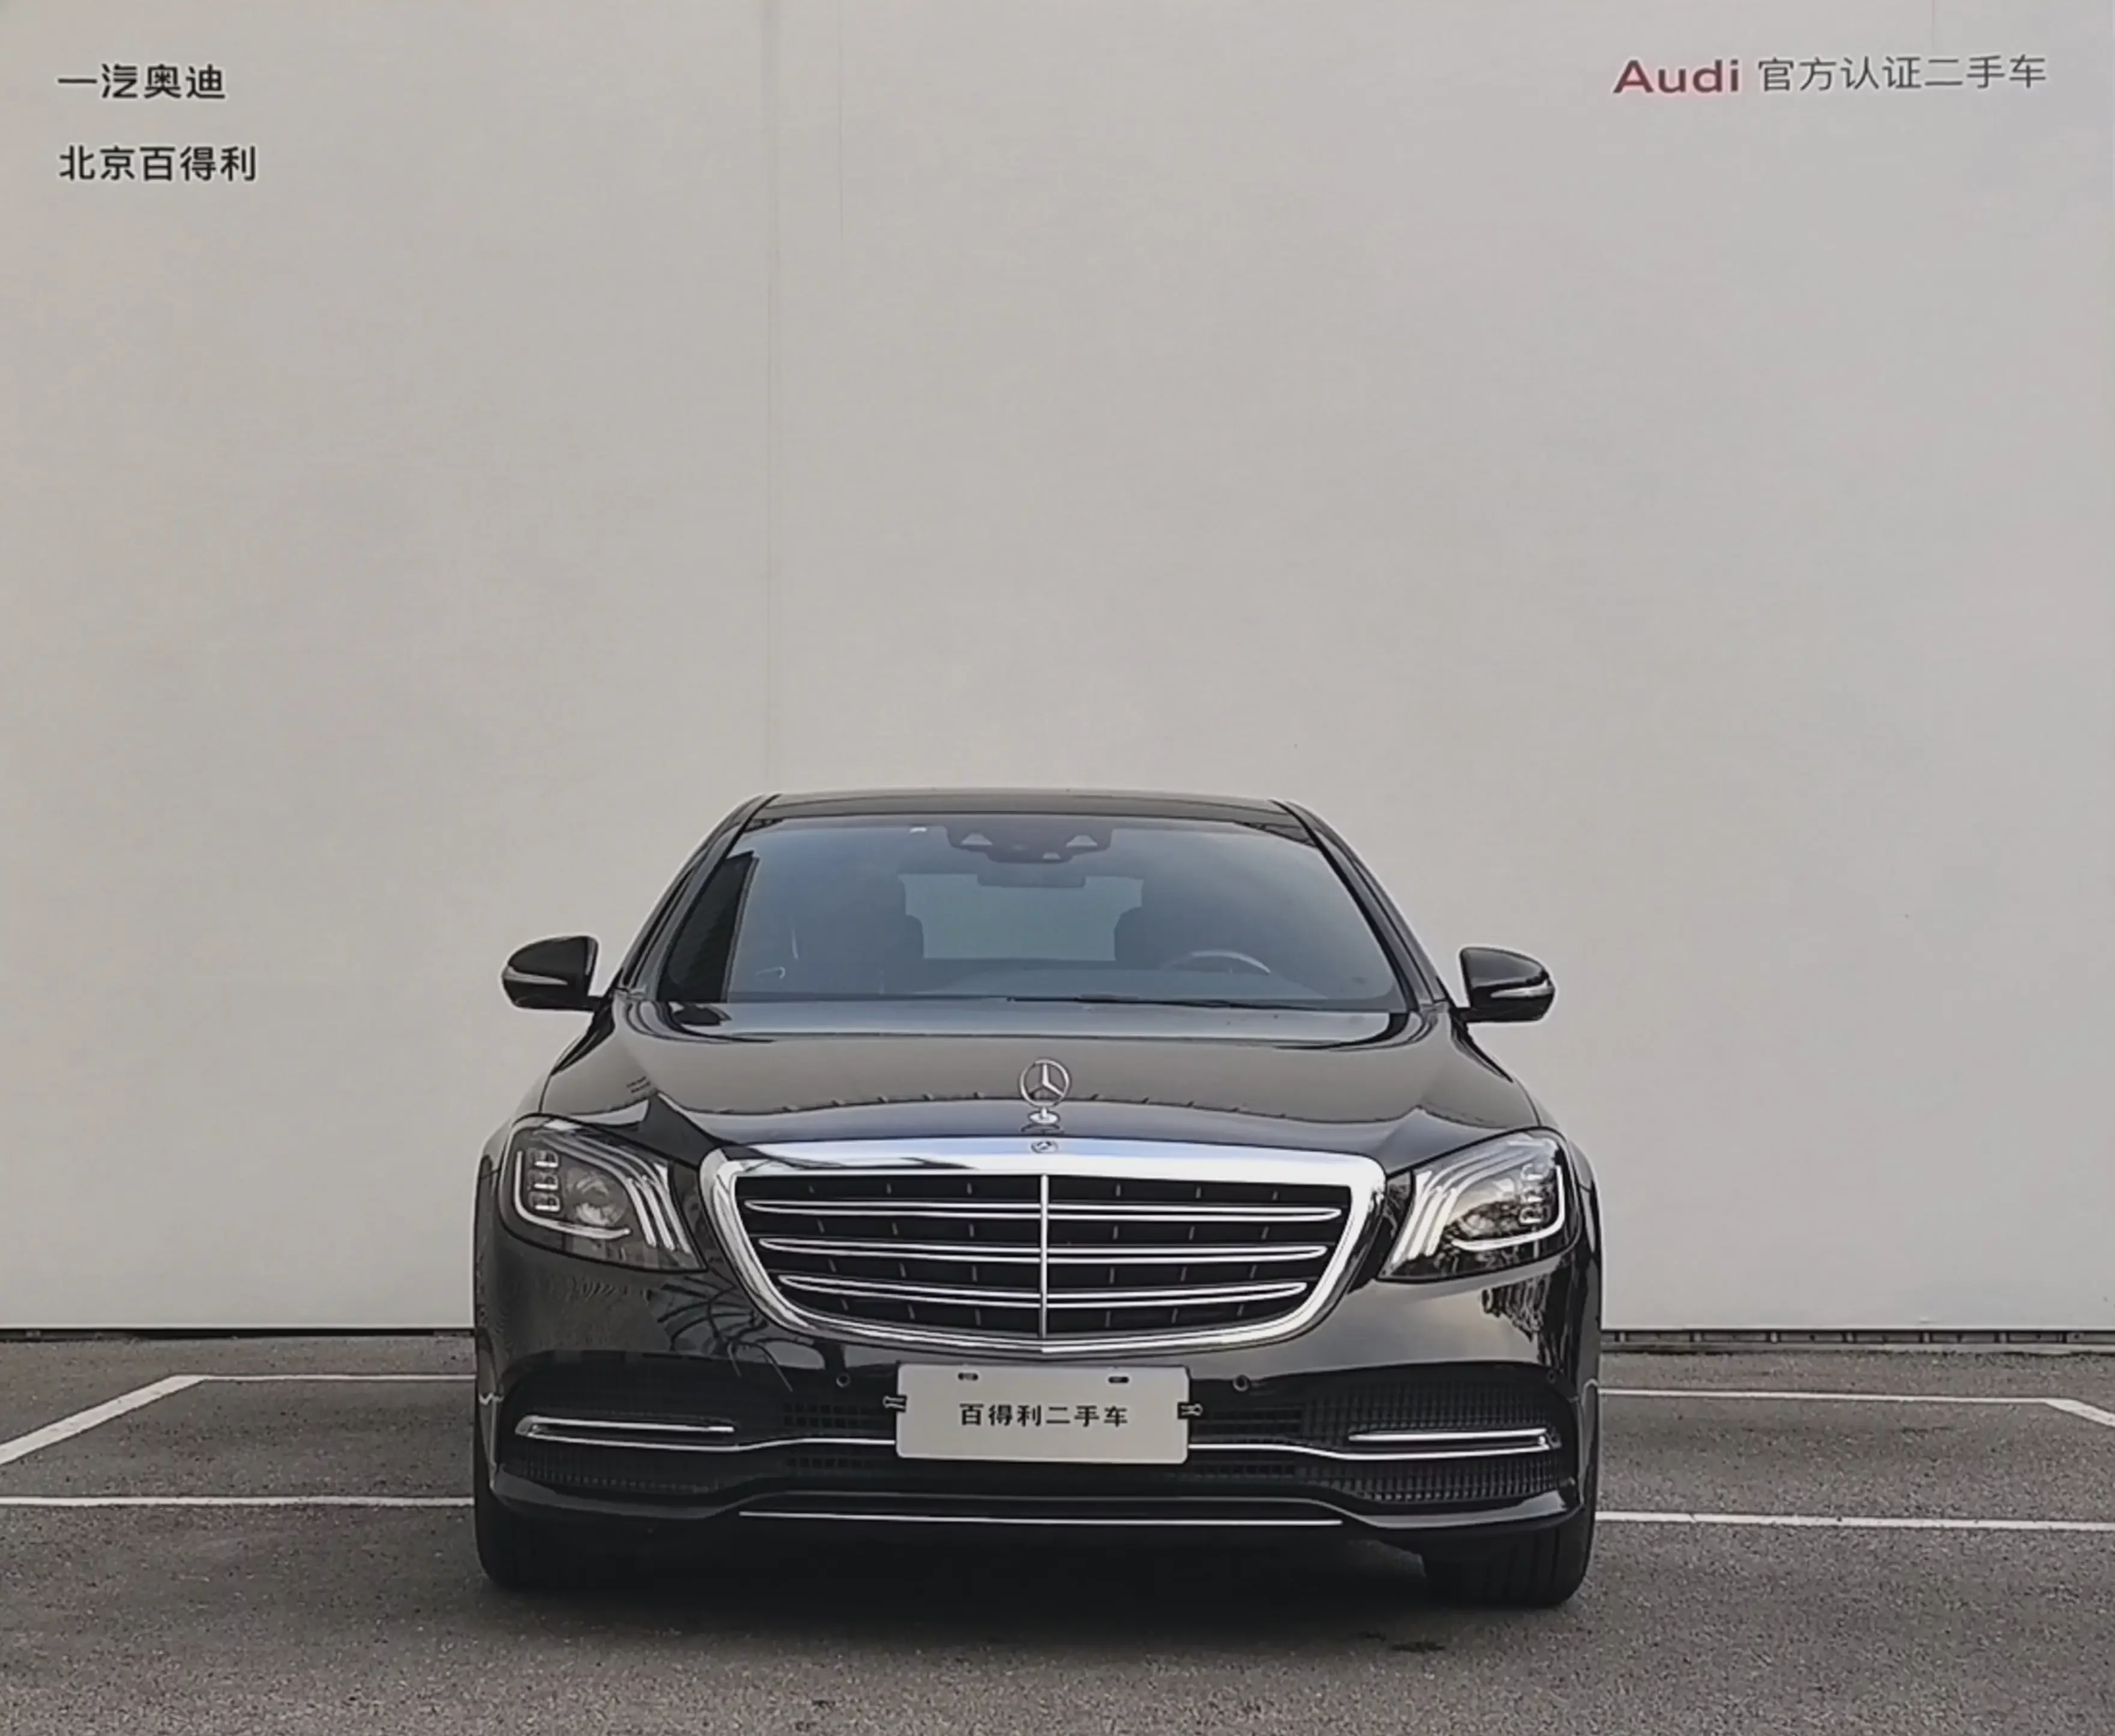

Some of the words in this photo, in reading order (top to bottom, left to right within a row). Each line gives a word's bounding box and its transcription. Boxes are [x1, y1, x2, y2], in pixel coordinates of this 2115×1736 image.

[57, 63, 227, 100] 一汽奥迪
[1613, 59, 1740, 94] Audi
[1757, 53, 2048, 93] 官方认证二手车
[58, 144, 257, 183] 北京百得利
[959, 1402, 1129, 1428] 百得利二手车
